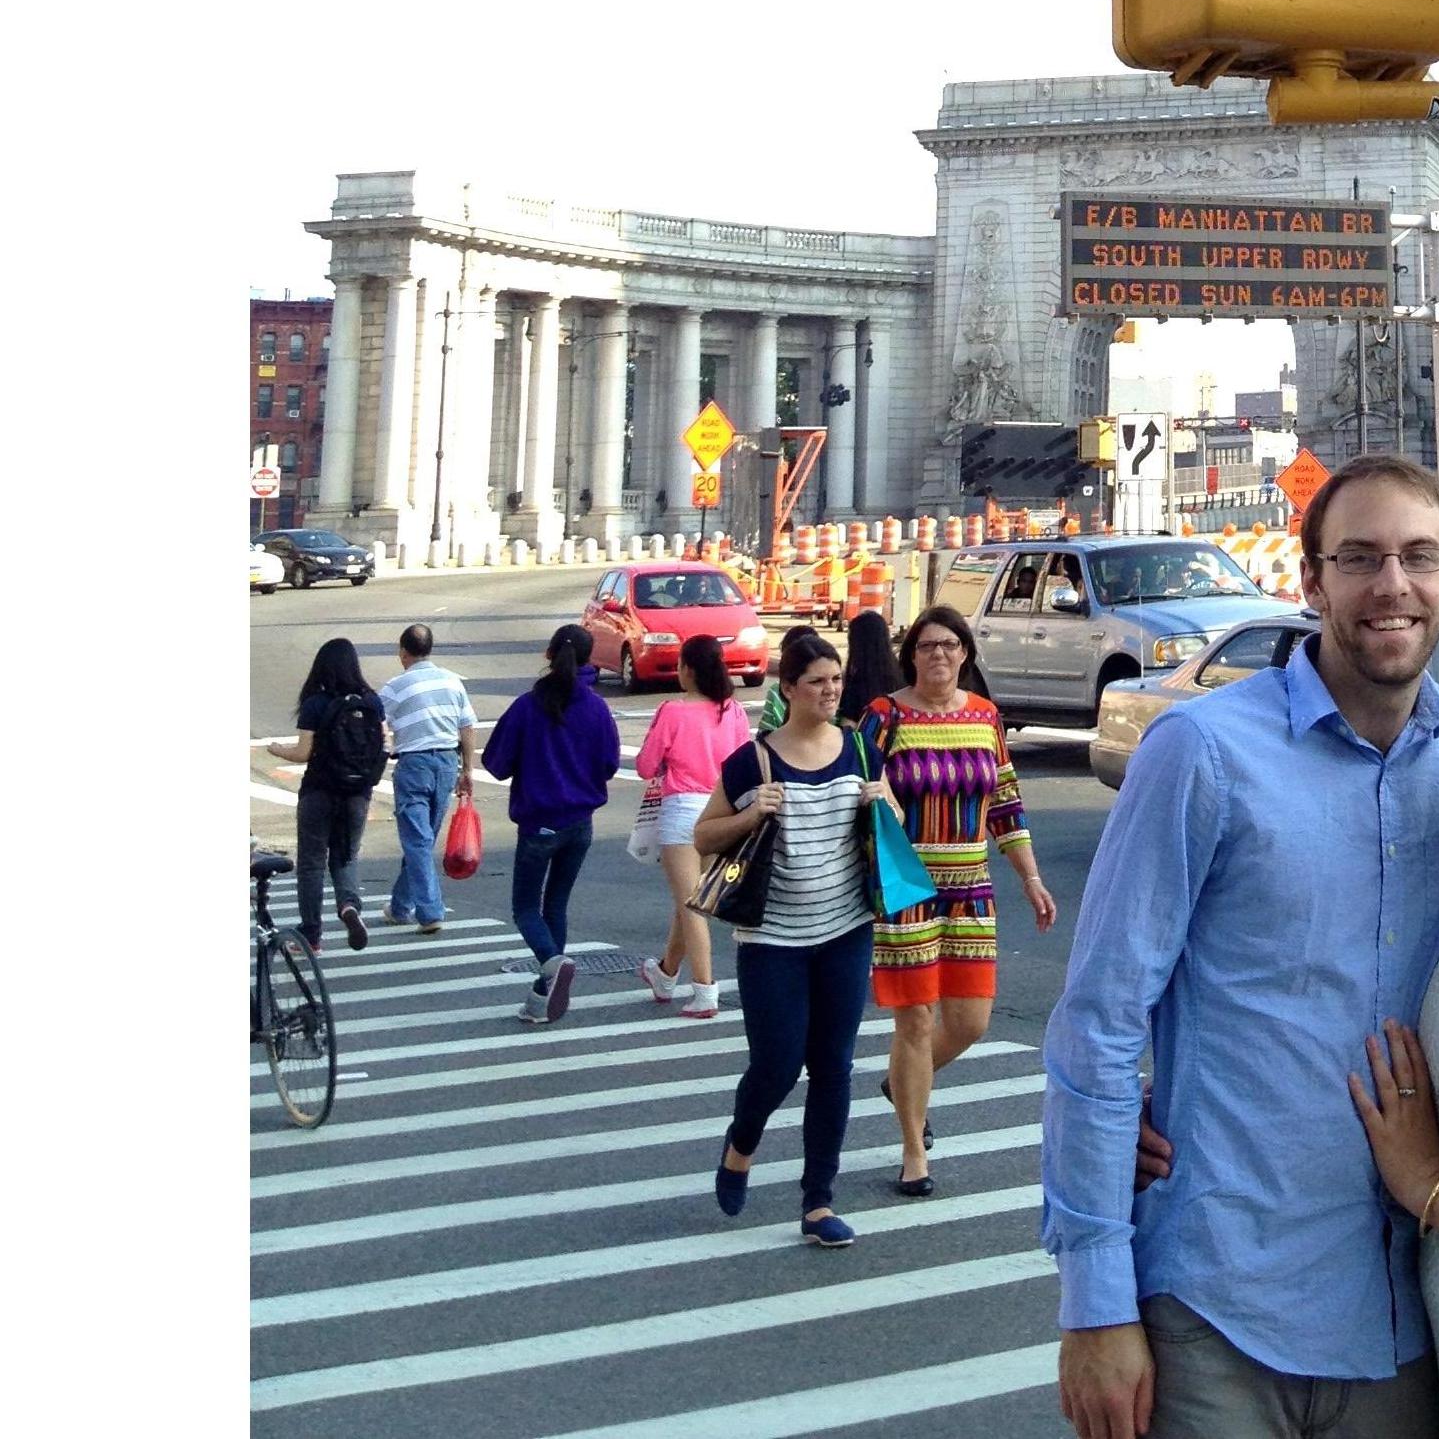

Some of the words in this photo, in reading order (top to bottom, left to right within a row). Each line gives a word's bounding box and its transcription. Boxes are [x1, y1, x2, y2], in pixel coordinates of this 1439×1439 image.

[1087, 205, 1137, 230] E/B
[1159, 207, 1323, 233] MANHATTAN
[1343, 212, 1373, 234] BR
[1092, 243, 1181, 269] SOUTH
[1202, 246, 1282, 269] UPPER
[1303, 248, 1368, 271] RDWY
[1074, 282, 1180, 307] CLOSED
[1201, 284, 1251, 307] SUN
[1272, 285, 1388, 308] 6AM-6PM
[1294, 465, 1316, 473] ROAD
[697, 476, 717, 492] 20
[1292, 489, 1315, 497] AHEA
